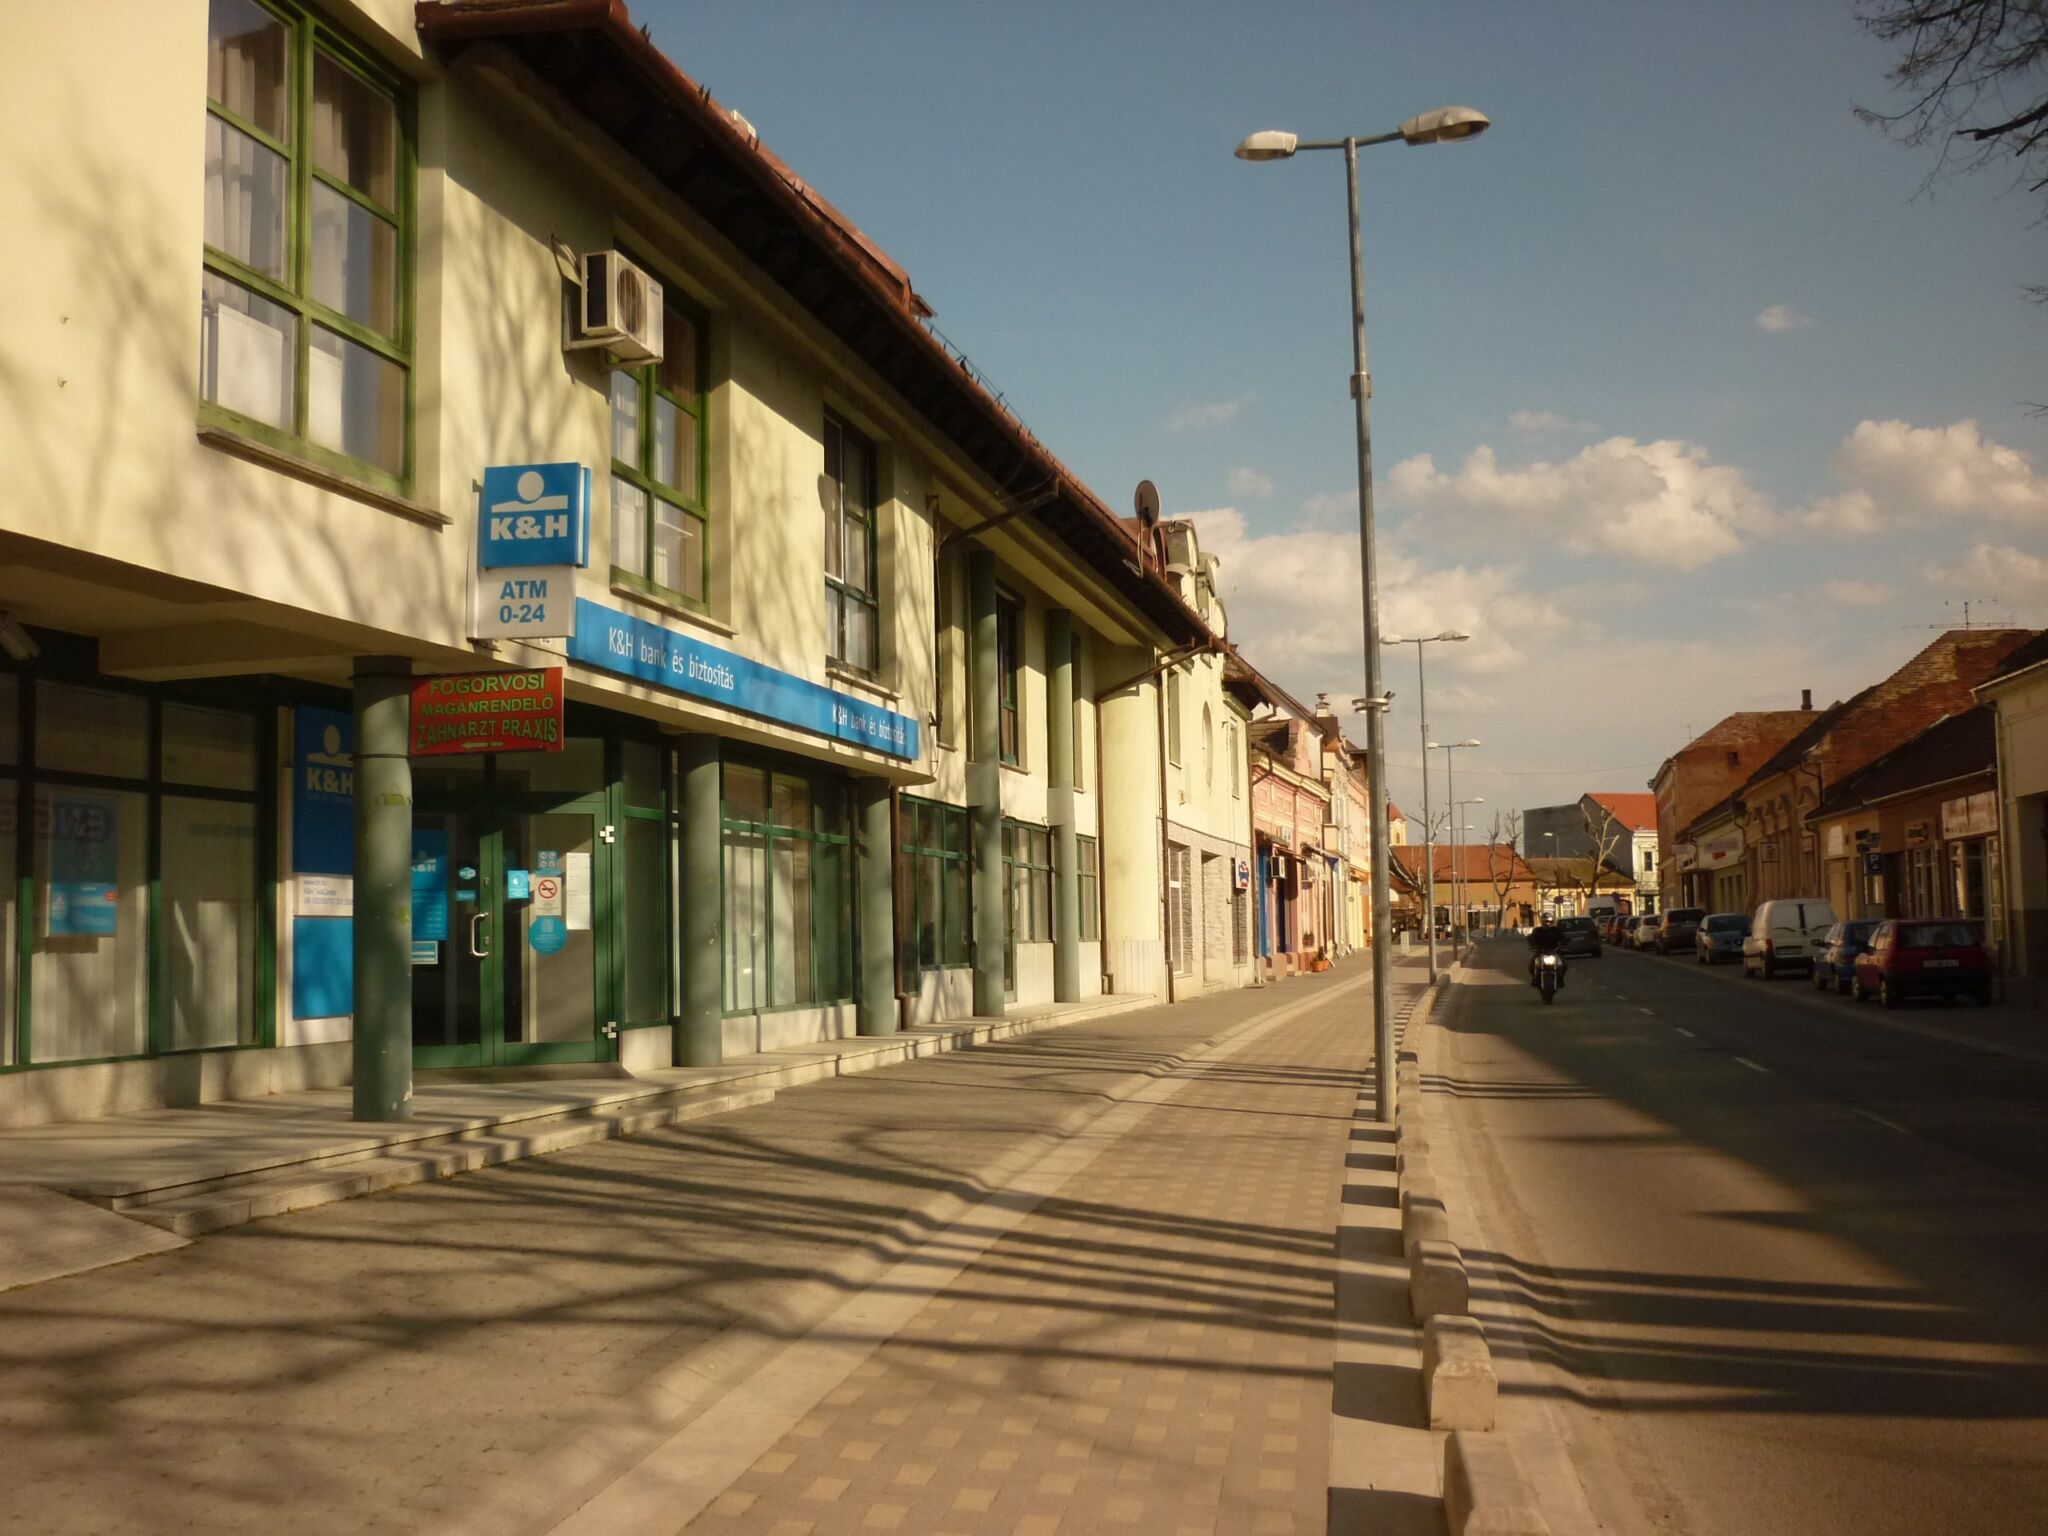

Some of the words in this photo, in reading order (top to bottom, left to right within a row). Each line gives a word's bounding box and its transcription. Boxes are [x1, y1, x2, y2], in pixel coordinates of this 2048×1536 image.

[490, 514, 569, 541] K&H
[500, 580, 547, 600] ATM
[500, 603, 546, 624] 0-24
[609, 625, 634, 658] K&H
[641, 636, 667, 668] bank
[672, 649, 684, 674] és
[689, 653, 735, 691] biztosítás
[430, 673, 545, 696] FOGORVOSI
[833, 703, 848, 727] K&H
[415, 719, 497, 750] ZAHNARZT
[502, 716, 558, 745] PRAXIS
[307, 767, 353, 796] K&H
